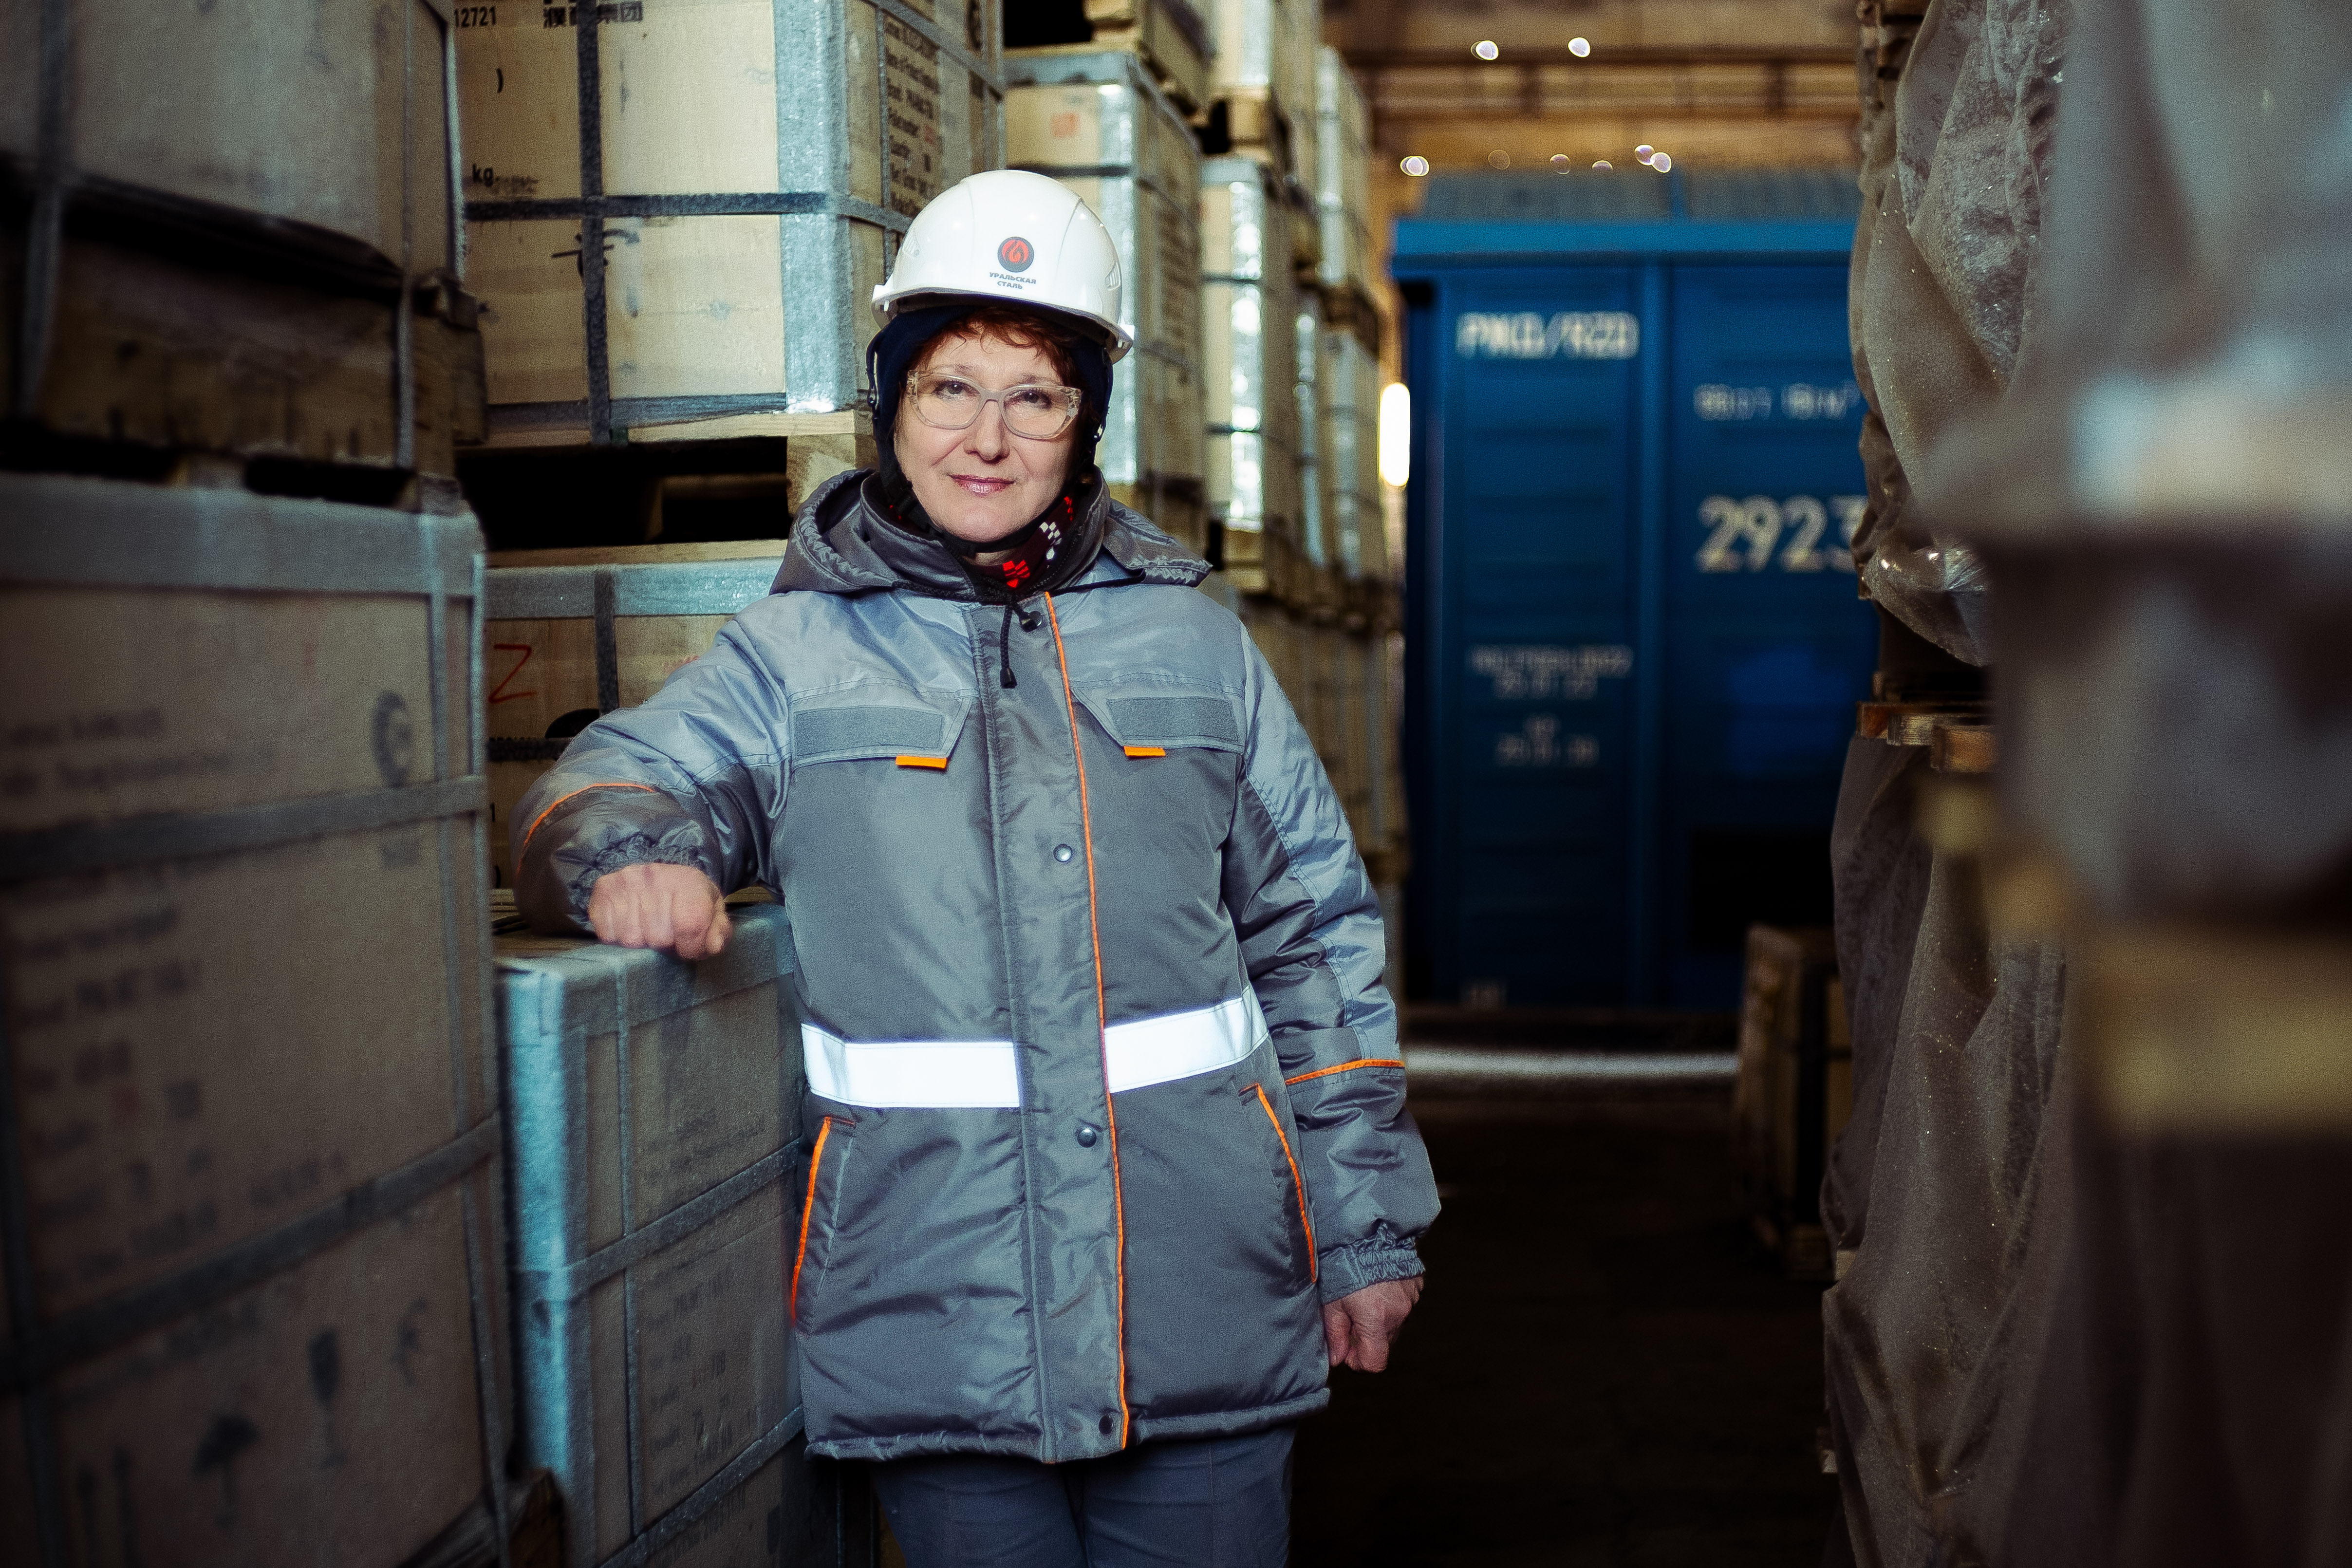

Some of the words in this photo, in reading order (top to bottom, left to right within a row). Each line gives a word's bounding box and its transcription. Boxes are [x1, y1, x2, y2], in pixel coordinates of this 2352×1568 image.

[454, 5, 497, 28] 12721
[472, 163, 494, 188] kg
[989, 271, 1037, 284] УРАЛЬСКАЯ
[997, 280, 1023, 289] СТАЛЬ
